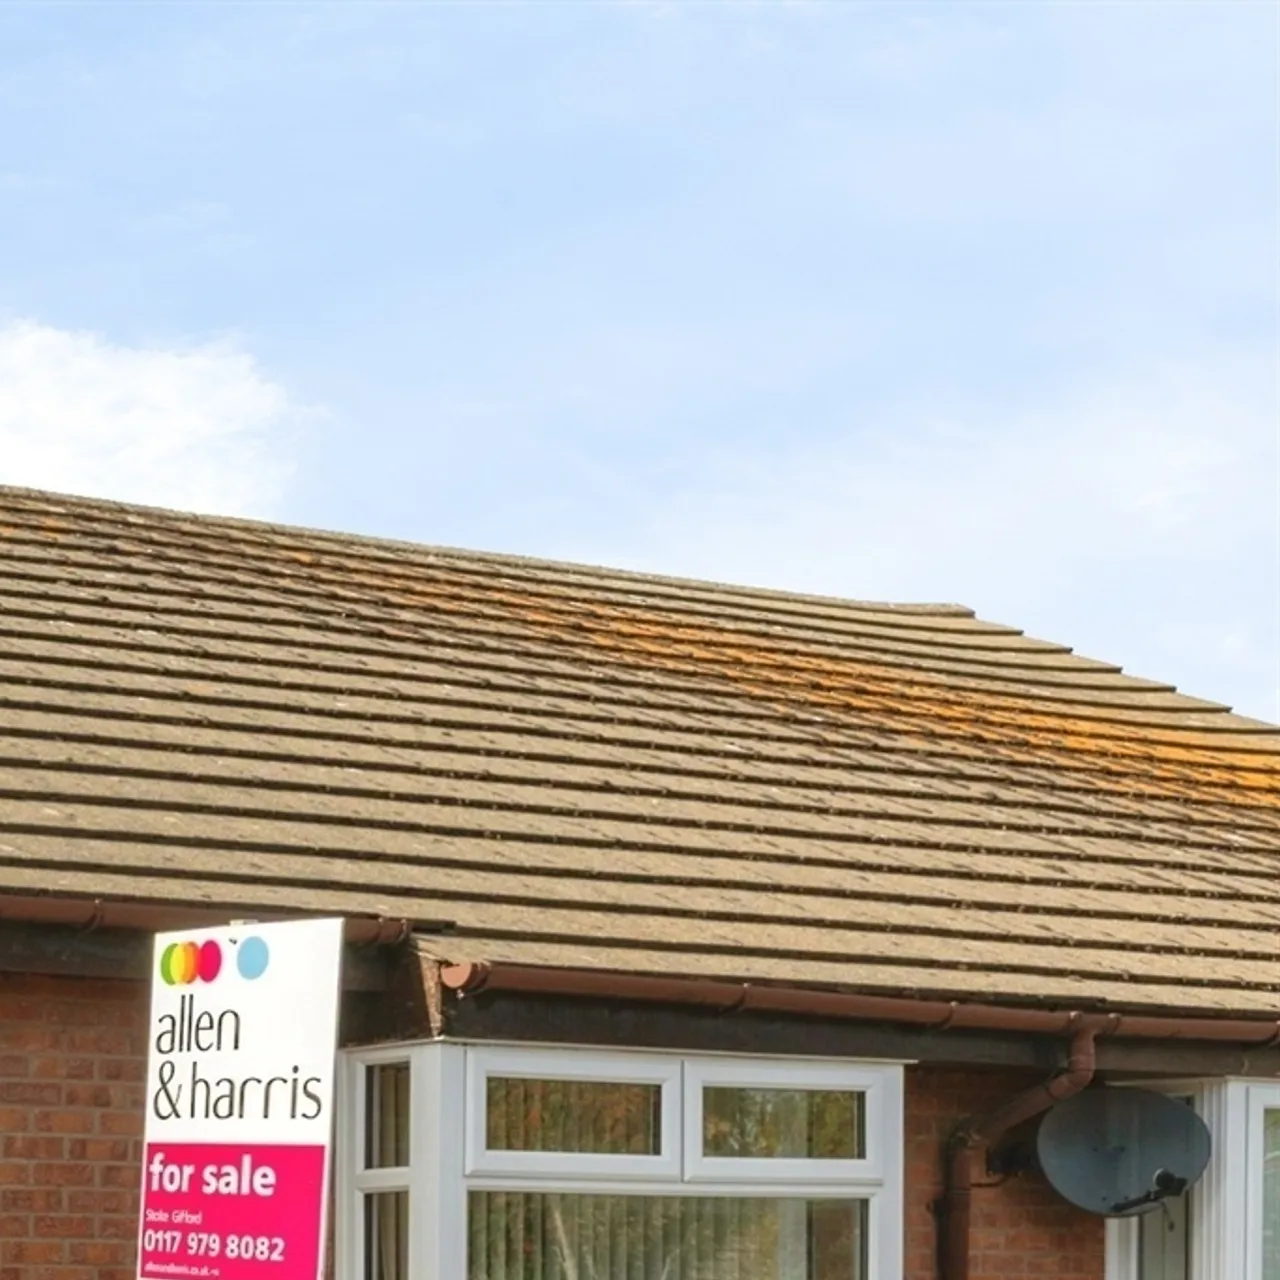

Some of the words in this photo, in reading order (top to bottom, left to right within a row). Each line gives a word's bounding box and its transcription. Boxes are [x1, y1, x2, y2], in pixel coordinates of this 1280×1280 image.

[156, 994, 241, 1054] allen
[149, 1153, 194, 1192] for
[202, 1154, 276, 1196] sale
[144, 1229, 182, 1253] 0117
[187, 1232, 221, 1258] 979
[226, 1235, 285, 1261] 8082
